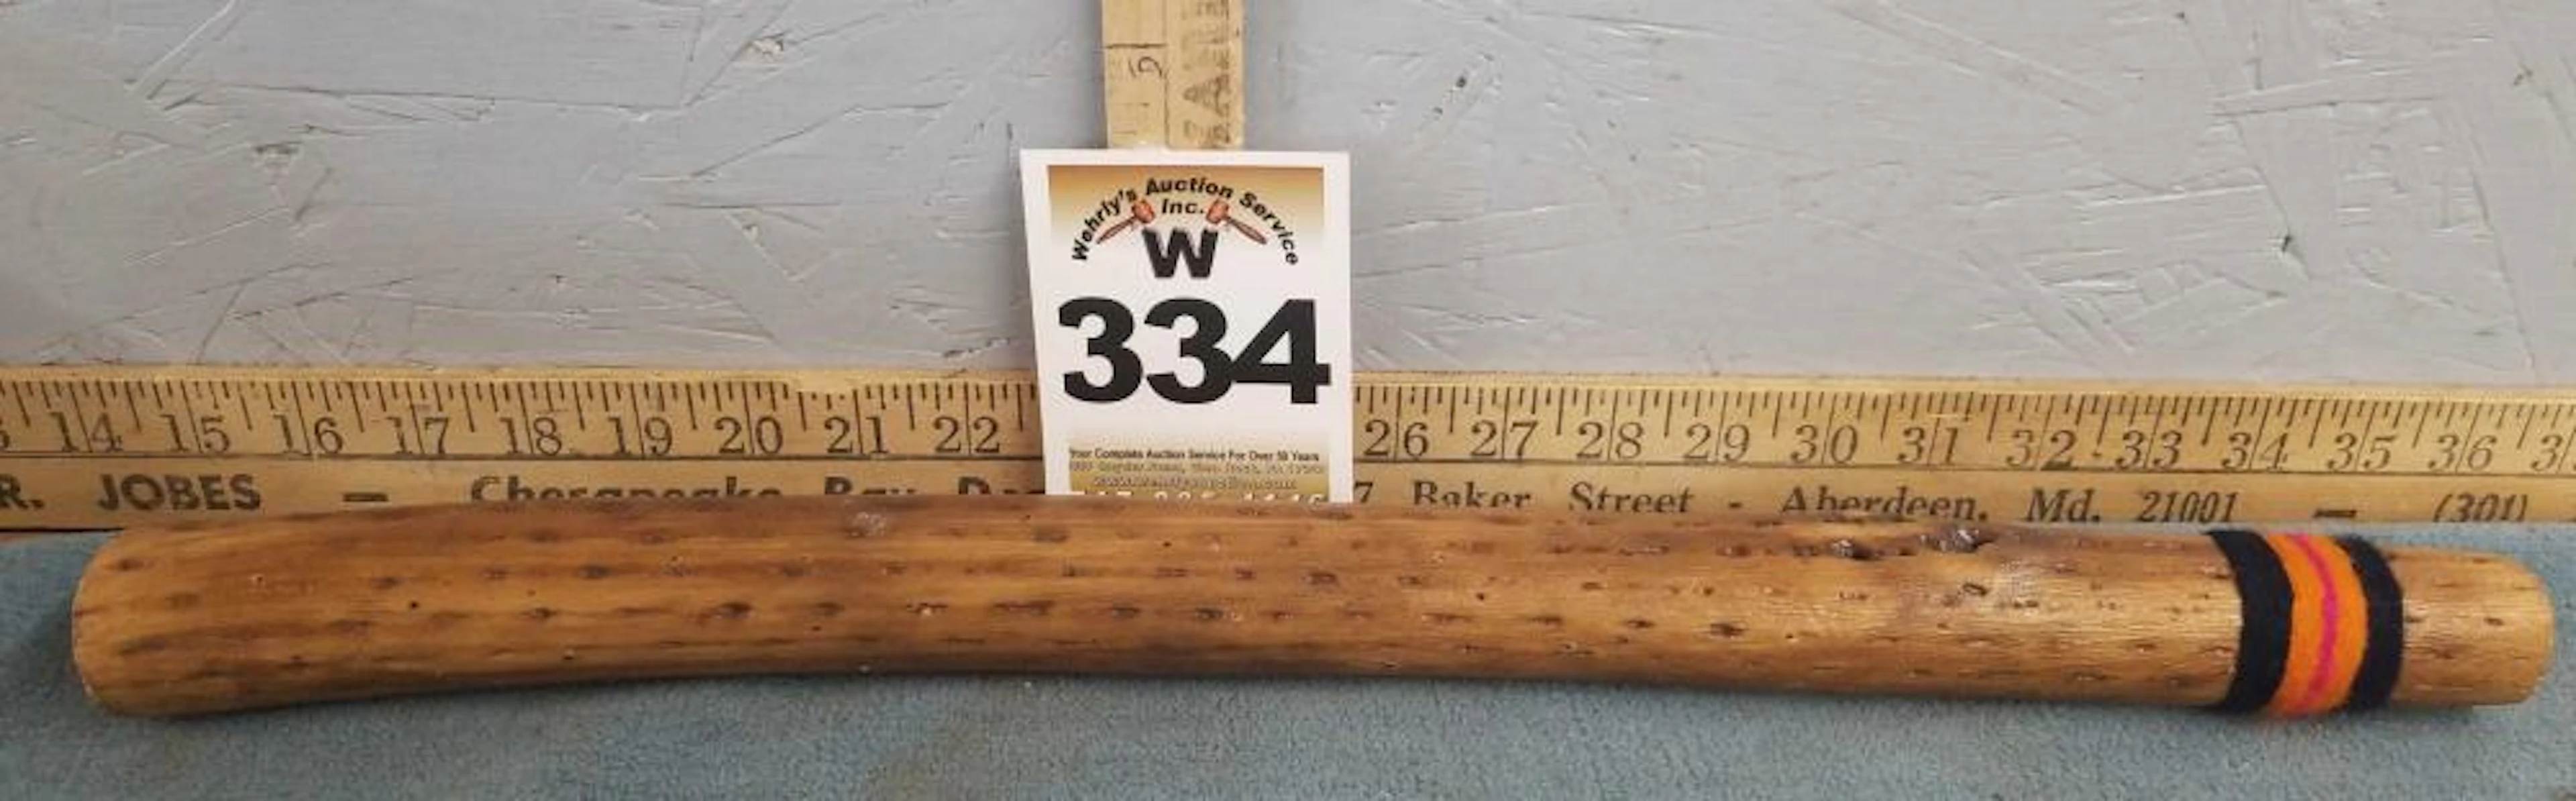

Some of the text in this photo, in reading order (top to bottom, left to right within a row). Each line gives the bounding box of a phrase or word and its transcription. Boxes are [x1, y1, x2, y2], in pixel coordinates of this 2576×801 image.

[1072, 176, 1298, 266] Wehrly's Auction Service
[1162, 199, 1204, 214] Inc.
[1142, 227, 1218, 278] W
[1058, 297, 1331, 404] 334
[51, 412, 123, 452] 14
[161, 414, 231, 452] 15
[274, 414, 343, 454] 16
[387, 417, 449, 454] 17
[501, 417, 561, 455] 18
[608, 417, 672, 455] 19
[714, 416, 783, 454] 20
[824, 416, 888, 454] 21
[934, 416, 1000, 453] 22
[1363, 420, 1429, 458] 26
[1471, 421, 1538, 458] 27
[1576, 421, 1644, 459] 28
[1683, 424, 1750, 462] 29
[1790, 425, 1859, 464] 30
[1897, 427, 1960, 465] 31
[2006, 429, 2077, 470] 32
[2115, 430, 2182, 468] 33
[2222, 432, 2289, 469] 34
[2326, 433, 2397, 469] 35
[2428, 434, 2497, 470] 36
[2530, 434, 2576, 471] 3
[1095, 447, 1143, 459] Complete
[1146, 449, 1185, 459] Auction
[1190, 449, 1225, 460] Service
[1229, 449, 1246, 460] For
[1249, 451, 1273, 461] Over
[1290, 450, 1319, 462] Years
[99, 474, 261, 510] JOBES
[1413, 480, 1531, 509] Baker
[1568, 481, 1695, 513] Street
[2026, 488, 2100, 523] Md.
[2137, 490, 2239, 523] 21001
[2432, 493, 2528, 523] (301)
